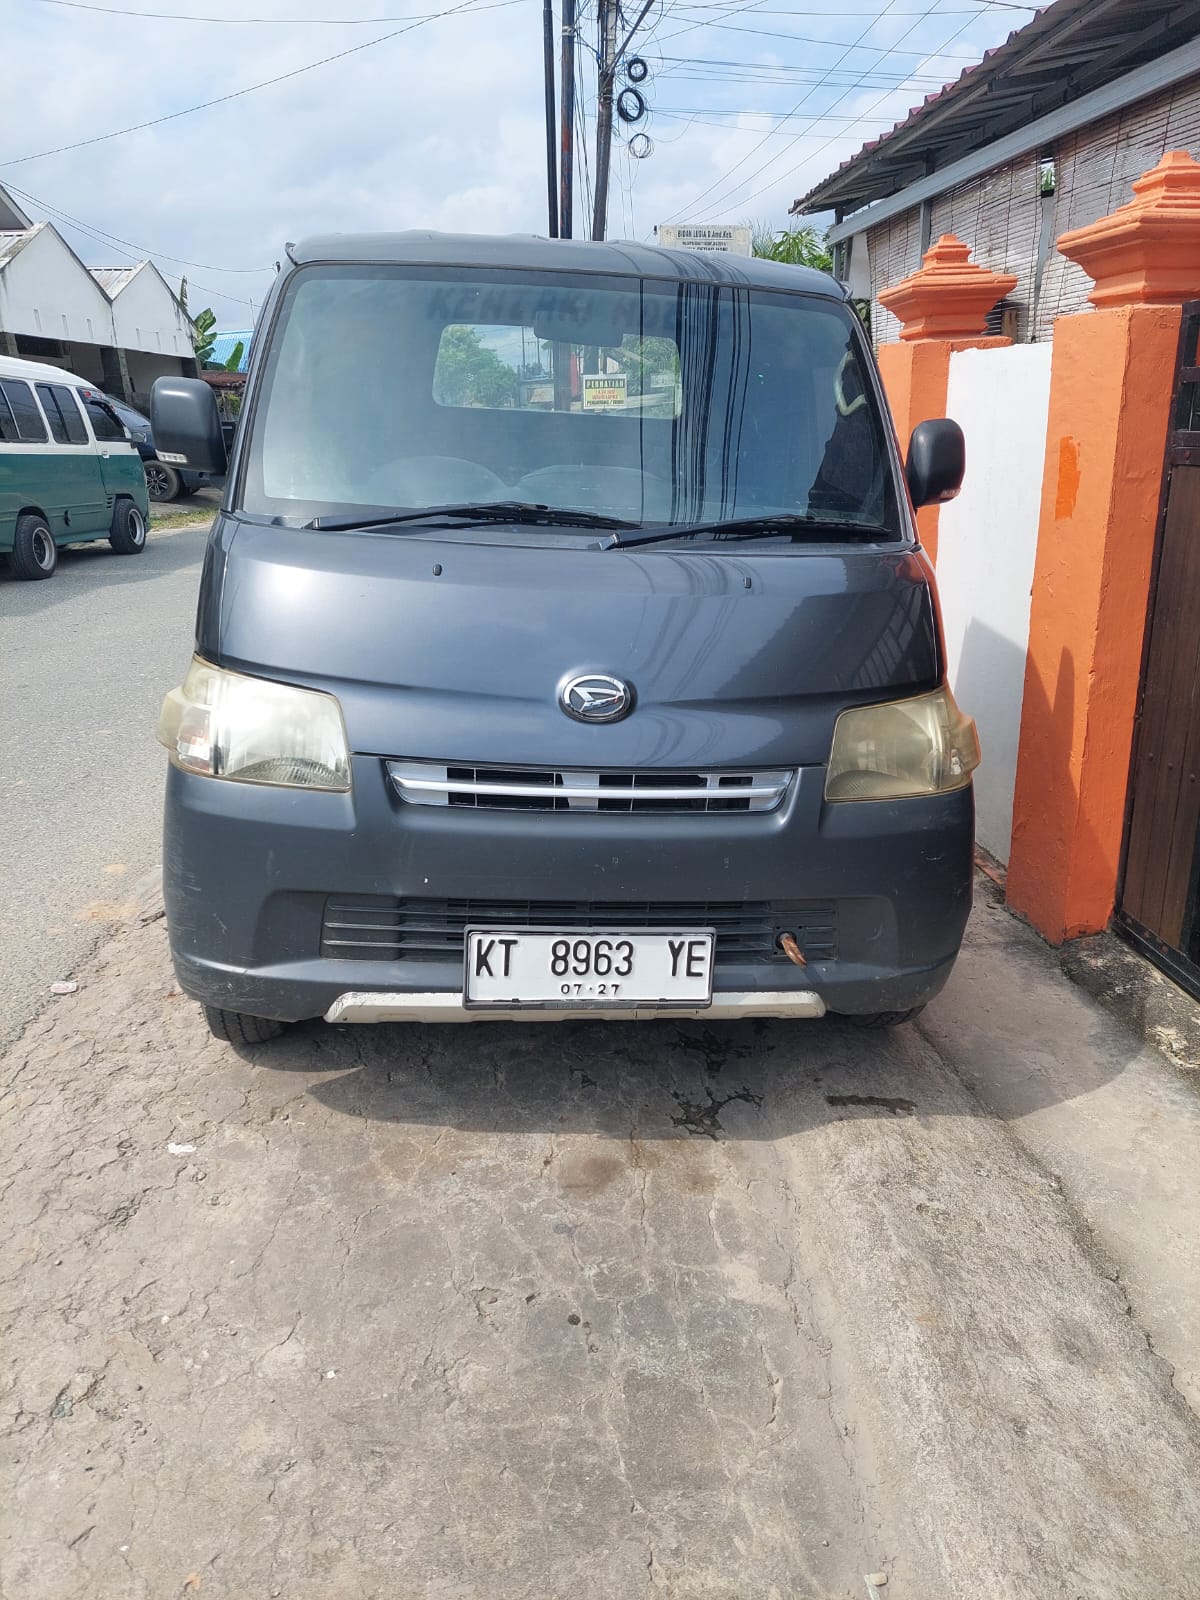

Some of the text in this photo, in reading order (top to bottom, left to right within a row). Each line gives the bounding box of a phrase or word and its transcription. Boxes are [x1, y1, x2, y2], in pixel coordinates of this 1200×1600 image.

[475, 938, 707, 977] KT 8963 YE
